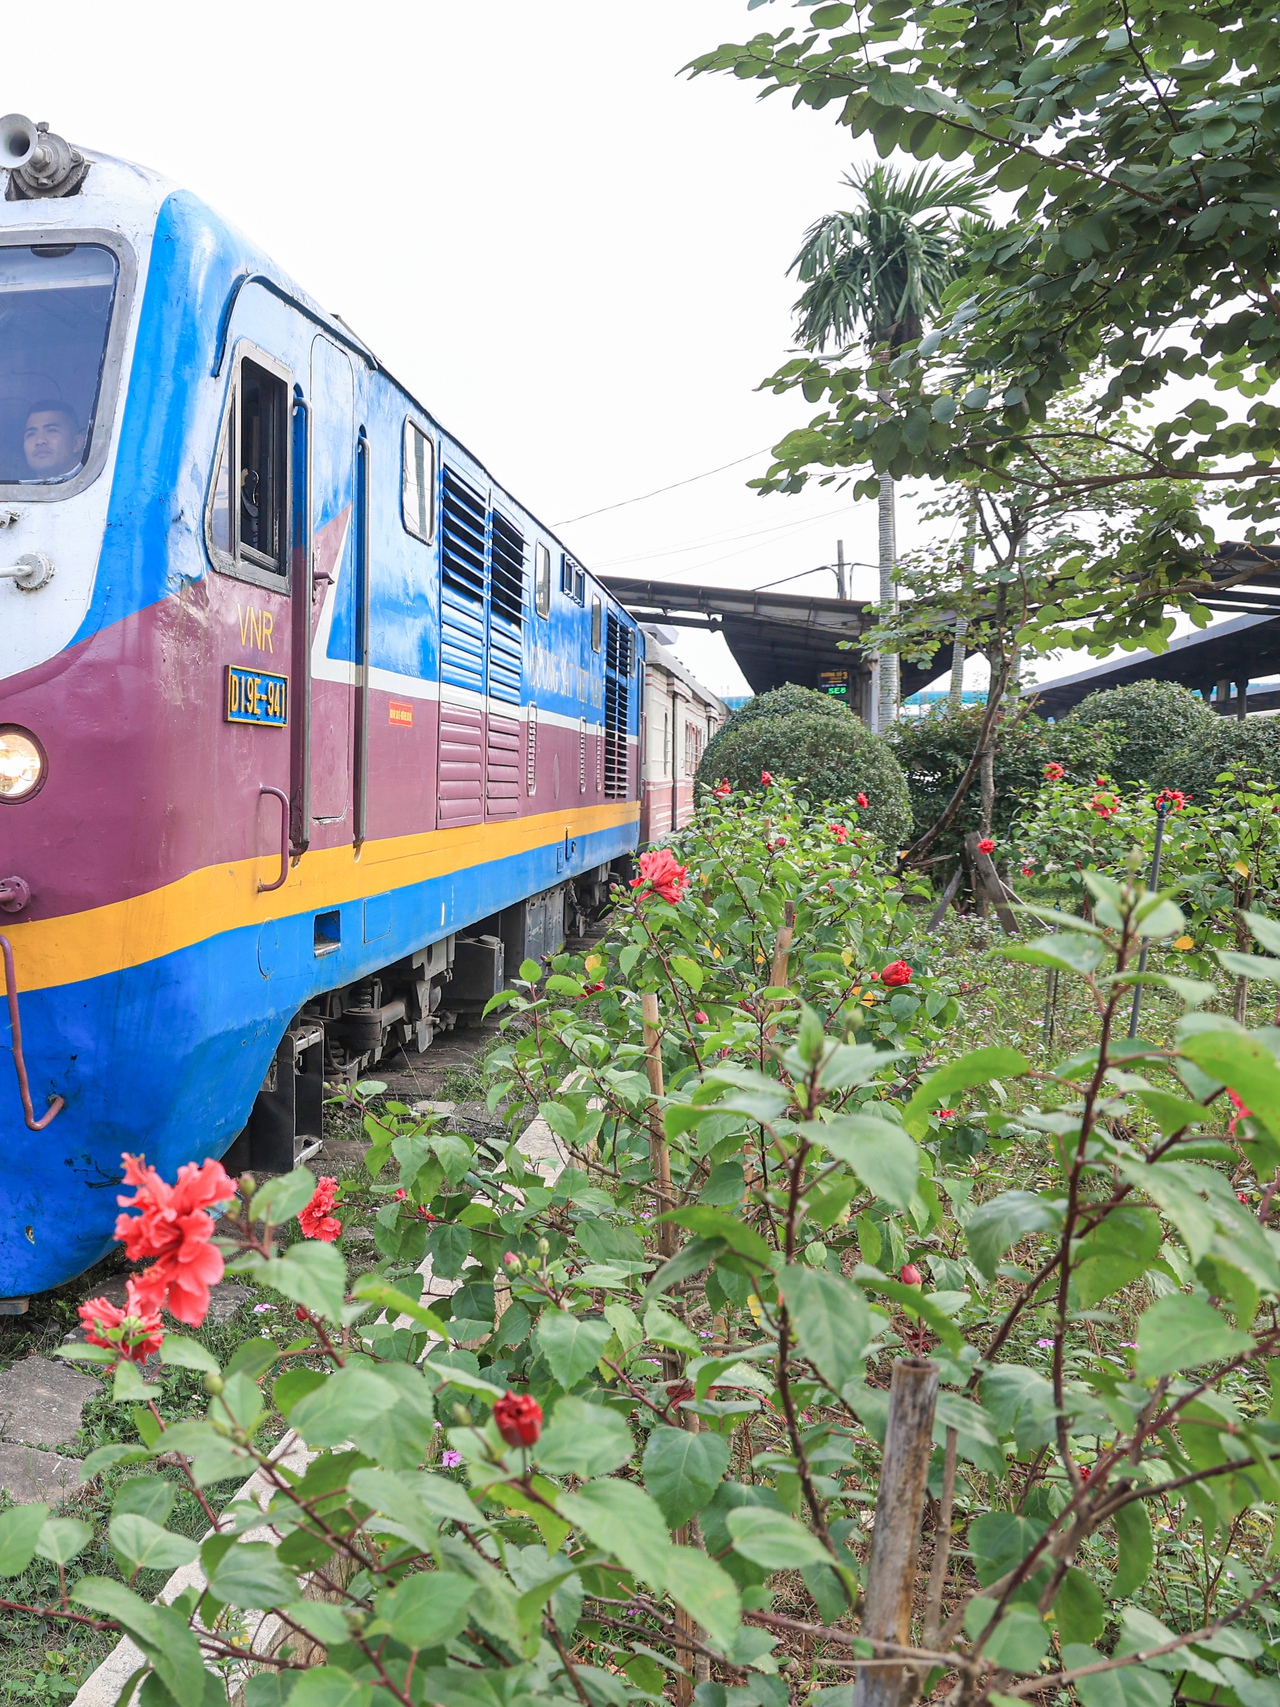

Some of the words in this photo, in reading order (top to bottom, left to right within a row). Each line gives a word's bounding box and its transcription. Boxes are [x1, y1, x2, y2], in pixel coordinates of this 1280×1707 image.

[237, 602, 274, 654] VNR
[231, 674, 286, 718] D19E-941
[842, 671, 848, 679] 3
